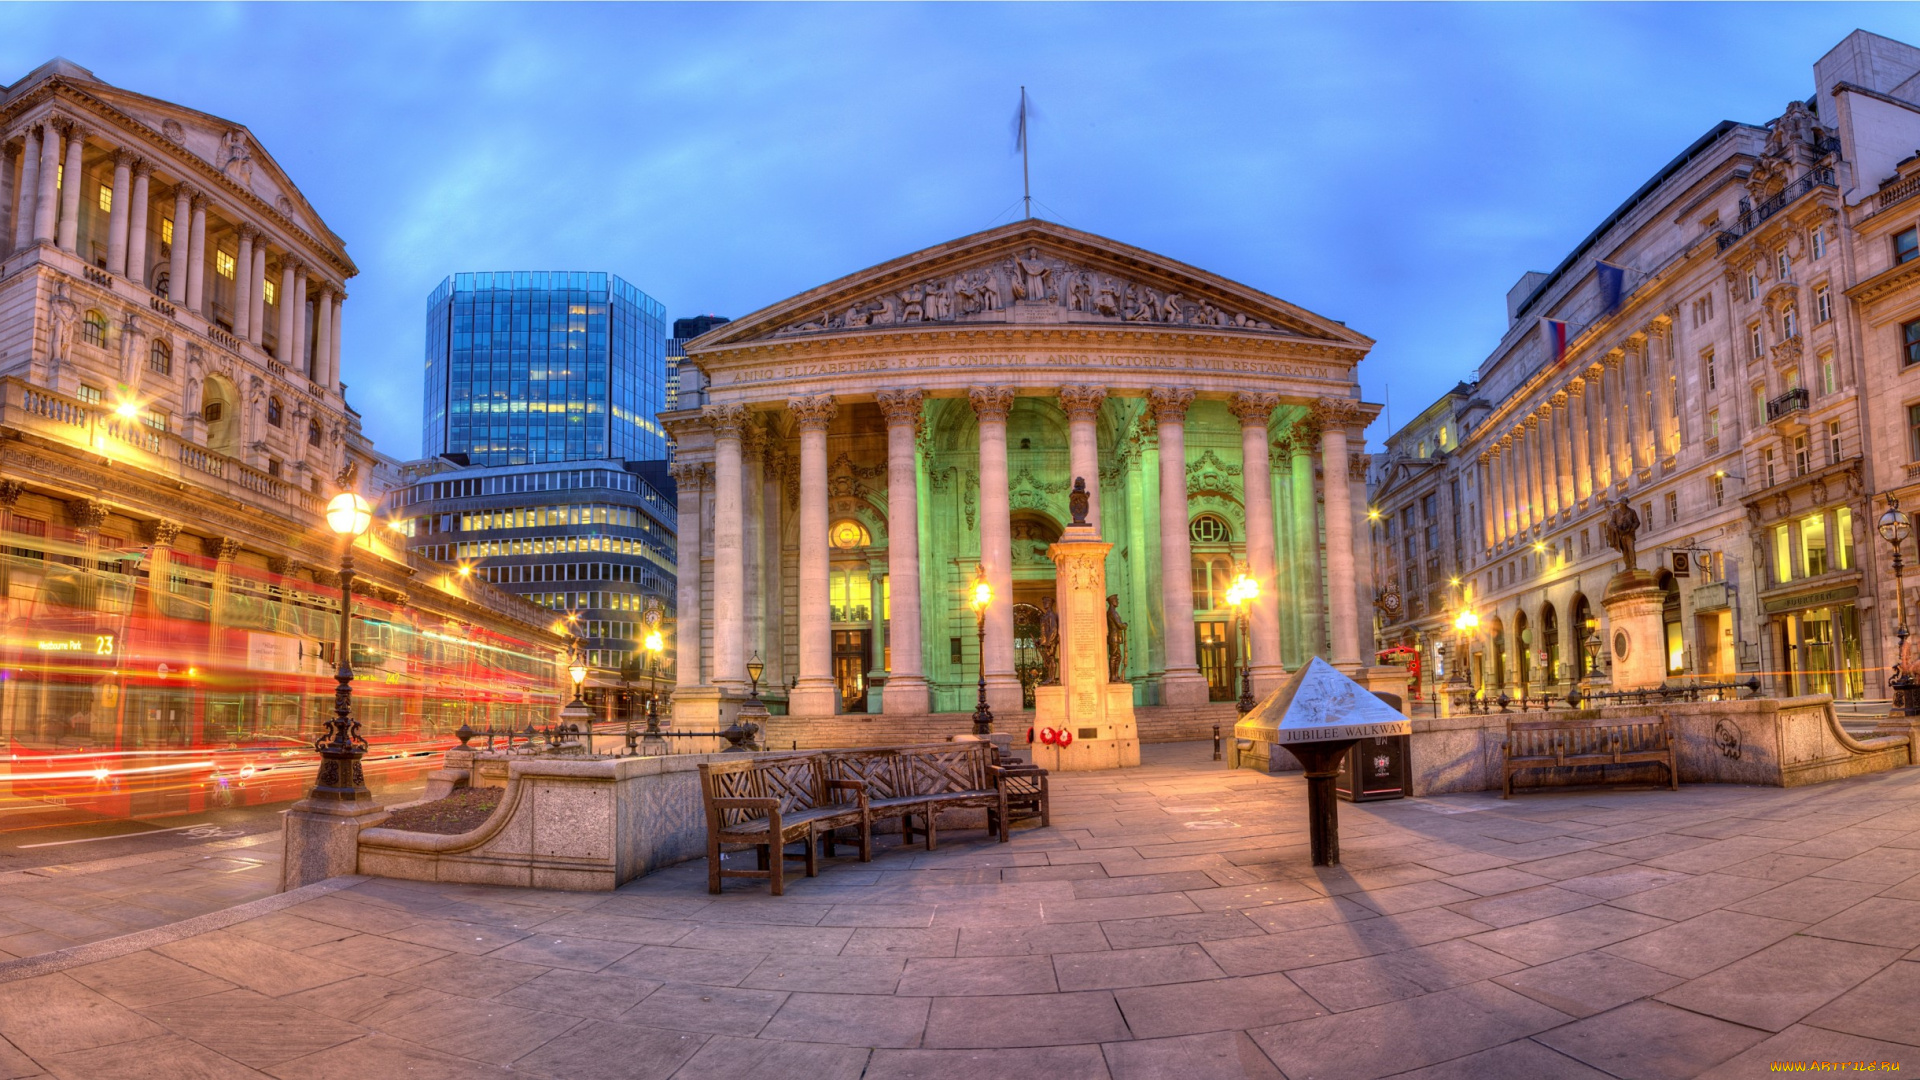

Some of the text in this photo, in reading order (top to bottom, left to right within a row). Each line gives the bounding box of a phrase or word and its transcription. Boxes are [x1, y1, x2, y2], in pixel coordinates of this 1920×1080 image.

[732, 354, 1329, 383] ANNO ELIZABETHAE R XIII CONDITVM ANNO VICTORIAE R VIII RESTAVRATVM
[69, 640, 82, 651] Park
[96, 635, 114, 655] 23
[385, 671, 400, 685] 242
[1287, 723, 1405, 742] JUBILEE WALKWAY
